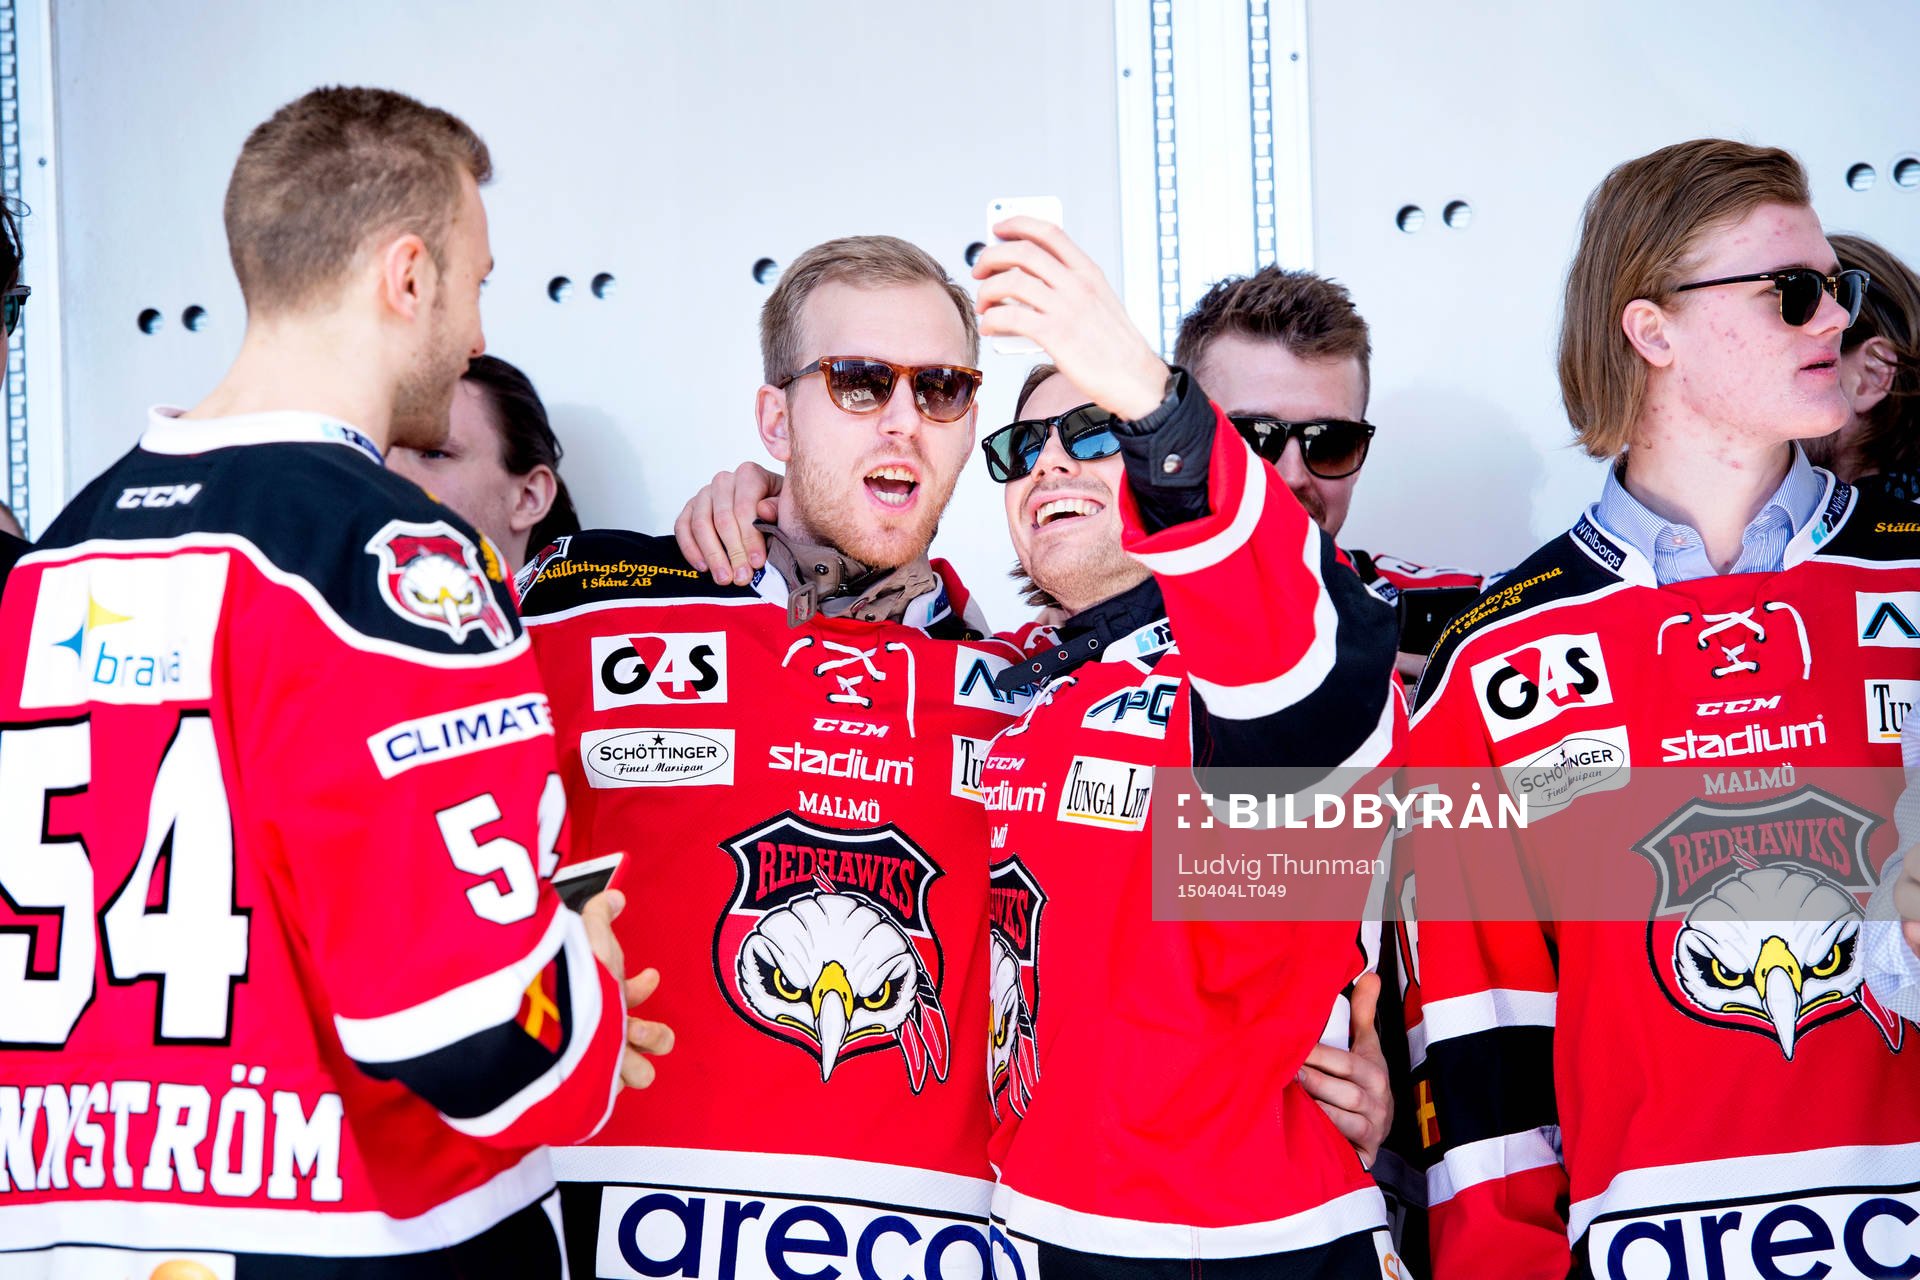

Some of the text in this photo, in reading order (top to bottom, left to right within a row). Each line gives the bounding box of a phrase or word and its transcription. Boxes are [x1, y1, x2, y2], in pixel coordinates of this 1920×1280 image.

[117, 483, 202, 508] CCM
[1575, 519, 1621, 568] Wihlborgs
[582, 577, 652, 589] i Skåne AB
[1501, 596, 1522, 610] AB
[601, 636, 719, 700] G4S
[1485, 647, 1599, 720] G4S
[1696, 696, 1781, 717] CCM
[813, 718, 889, 738] CCM
[1661, 718, 1826, 763] stadium
[600, 744, 717, 761] SCHÖTTINGER
[614, 762, 703, 775] Finest Marsipan
[768, 742, 914, 786] stadium
[986, 757, 1026, 771] CCM
[1703, 762, 1796, 795] MALMÖ
[798, 790, 880, 823] MALMÖ
[1669, 817, 1851, 897] REDHAWKS
[0, 709, 252, 1050] 54
[755, 842, 916, 919] REDHAWKS
[617, 1192, 993, 1280] areco
